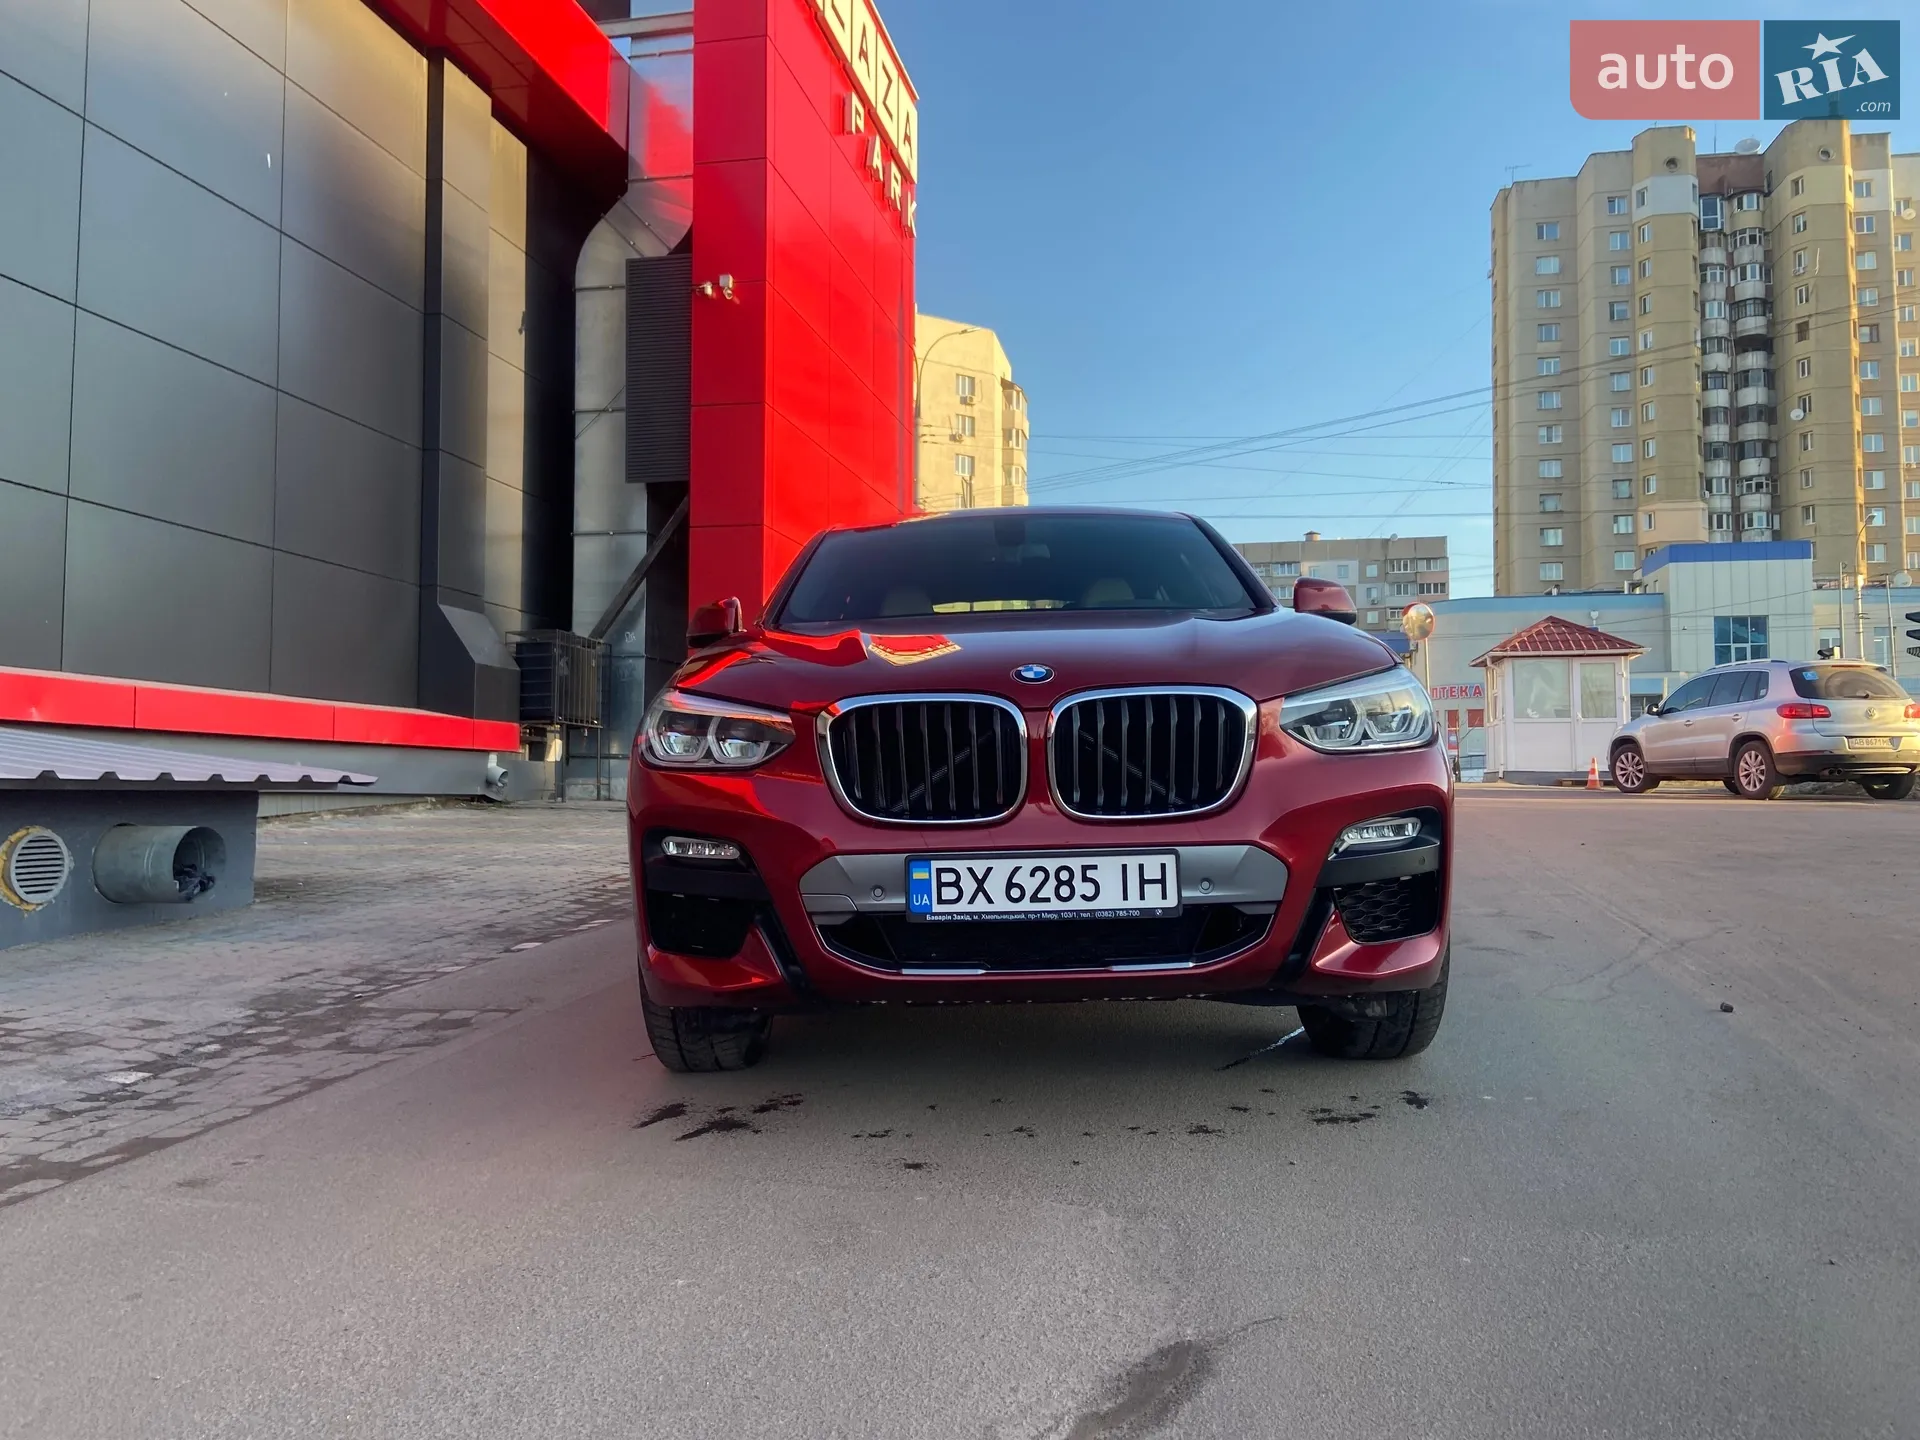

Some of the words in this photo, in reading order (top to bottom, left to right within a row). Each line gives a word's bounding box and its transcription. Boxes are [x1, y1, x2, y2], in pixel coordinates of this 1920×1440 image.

[850, 91, 917, 238] PARK
[935, 866, 995, 905] BX
[1004, 864, 1101, 904] 6285
[1120, 862, 1168, 902] IH
[913, 894, 930, 906] UA
[1095, 910, 1115, 919] (0382)
[1116, 909, 1140, 917] 785-700
